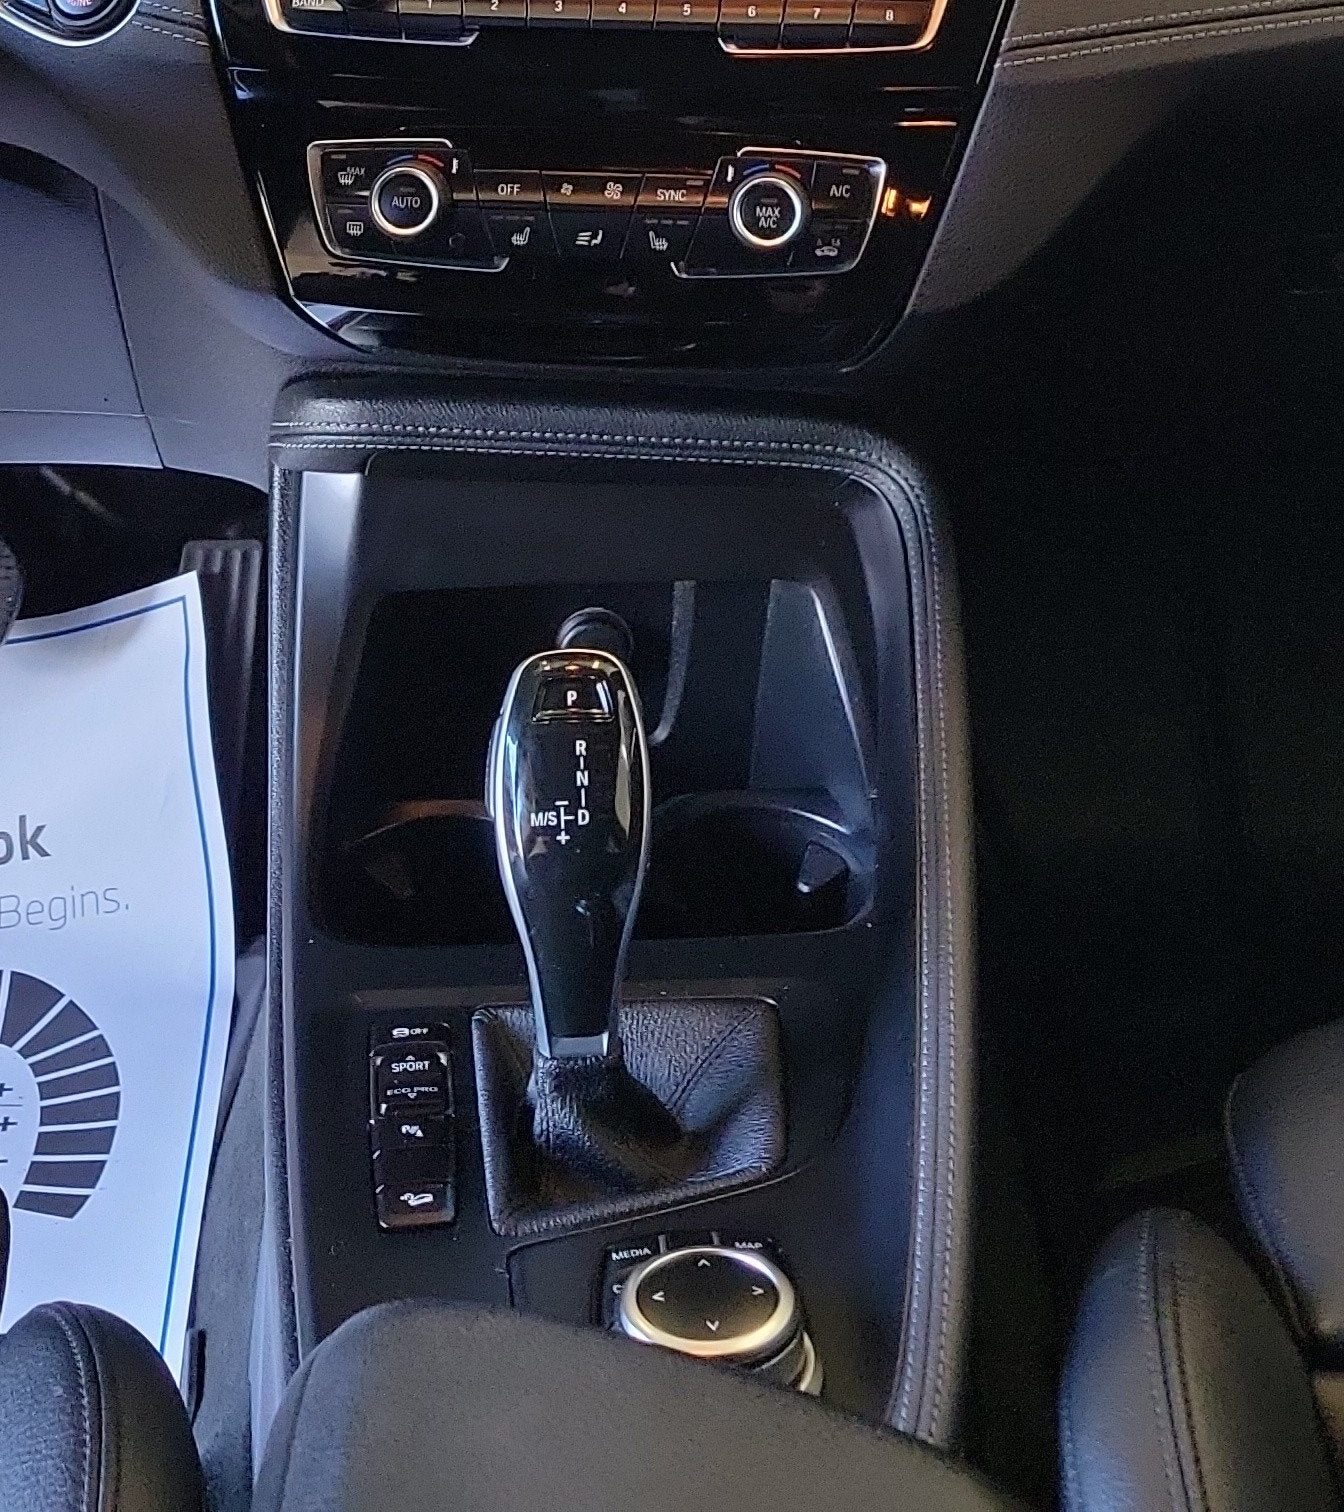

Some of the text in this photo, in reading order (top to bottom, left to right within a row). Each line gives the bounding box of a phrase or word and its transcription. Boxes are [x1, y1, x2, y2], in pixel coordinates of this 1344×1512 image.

[490, 0, 499, 11] 2
[554, 0, 563, 12] 3
[618, 1, 627, 14] 4
[682, 3, 691, 16] 5
[747, 6, 756, 17] 6
[812, 7, 821, 20] 7
[885, 9, 894, 21] 8
[346, 166, 365, 176] MAX
[498, 183, 521, 196] OFF
[656, 188, 687, 201] SYNC
[829, 184, 851, 197] A/C
[391, 196, 421, 209] AUTO
[756, 205, 781, 217] MAX
[759, 216, 777, 229] A/C
[566, 690, 578, 707] P
[575, 739, 587, 756] R
[576, 769, 589, 787] N
[530, 811, 558, 827] M/S
[577, 808, 590, 826] D
[391, 1060, 431, 1073] SPORT
[386, 1085, 439, 1096] ECO PRO
[611, 1246, 652, 1261] MEDIA
